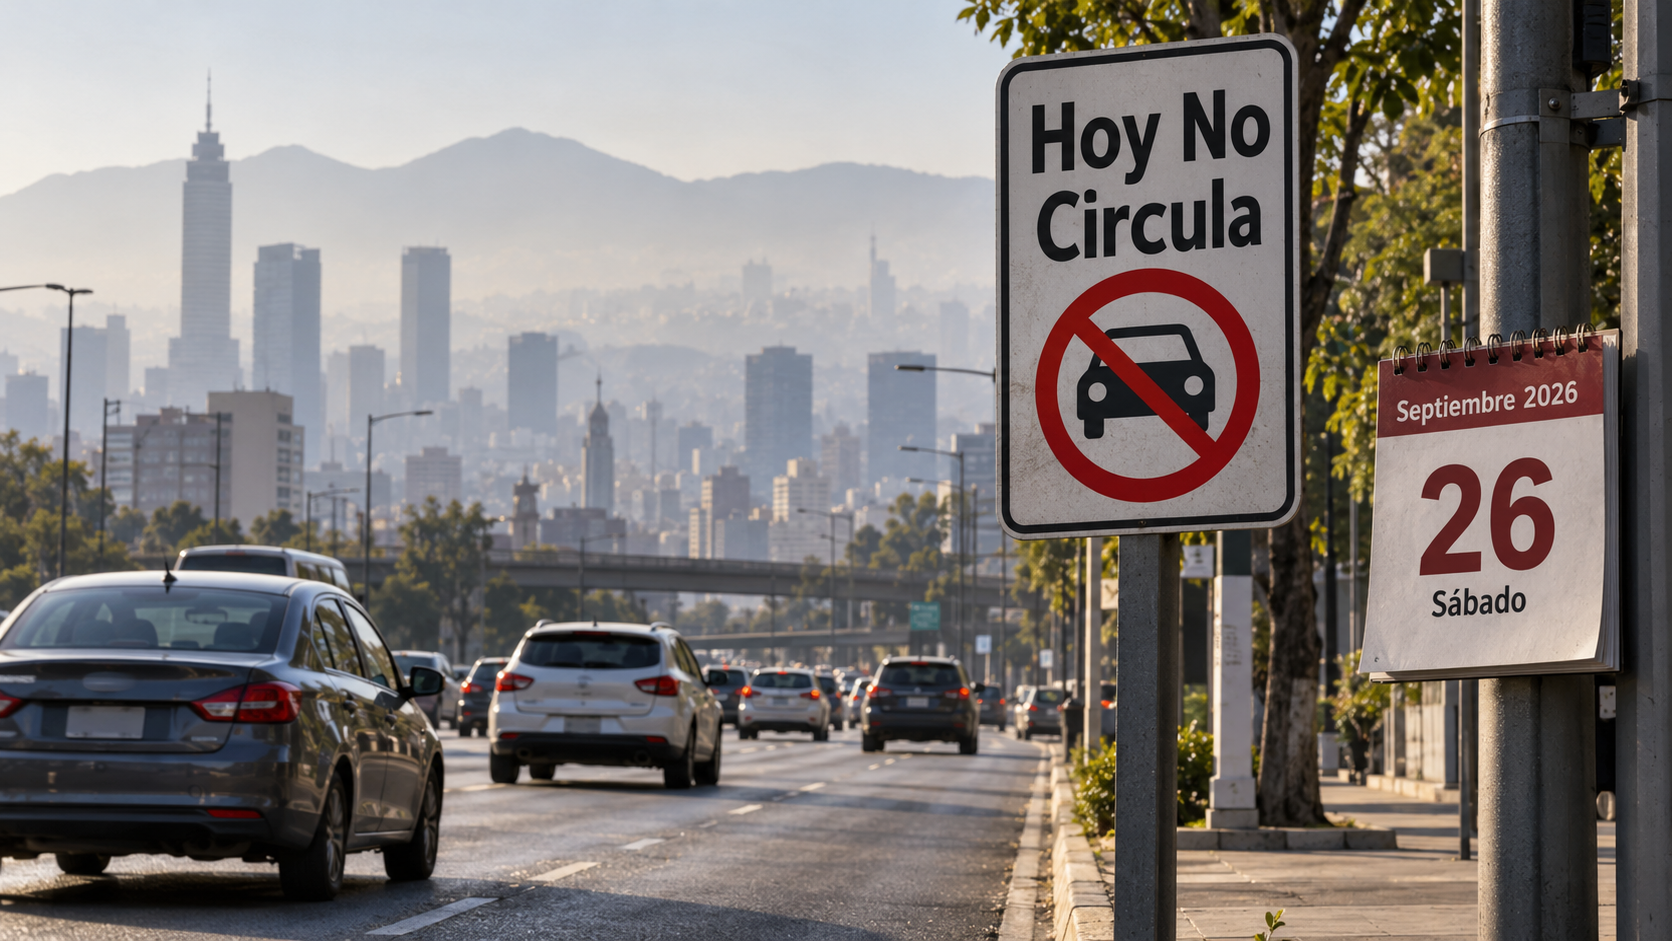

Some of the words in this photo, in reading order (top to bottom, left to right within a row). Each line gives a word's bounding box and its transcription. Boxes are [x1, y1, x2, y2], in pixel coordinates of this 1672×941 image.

[1032, 101, 1161, 185] Hoy
[1183, 89, 1270, 162] No
[1036, 178, 1262, 262] Circula
[1396, 390, 1516, 426] Septiembre
[1523, 380, 1579, 409] 2026
[1419, 457, 1555, 576] 26
[1431, 585, 1527, 617] Sábado
